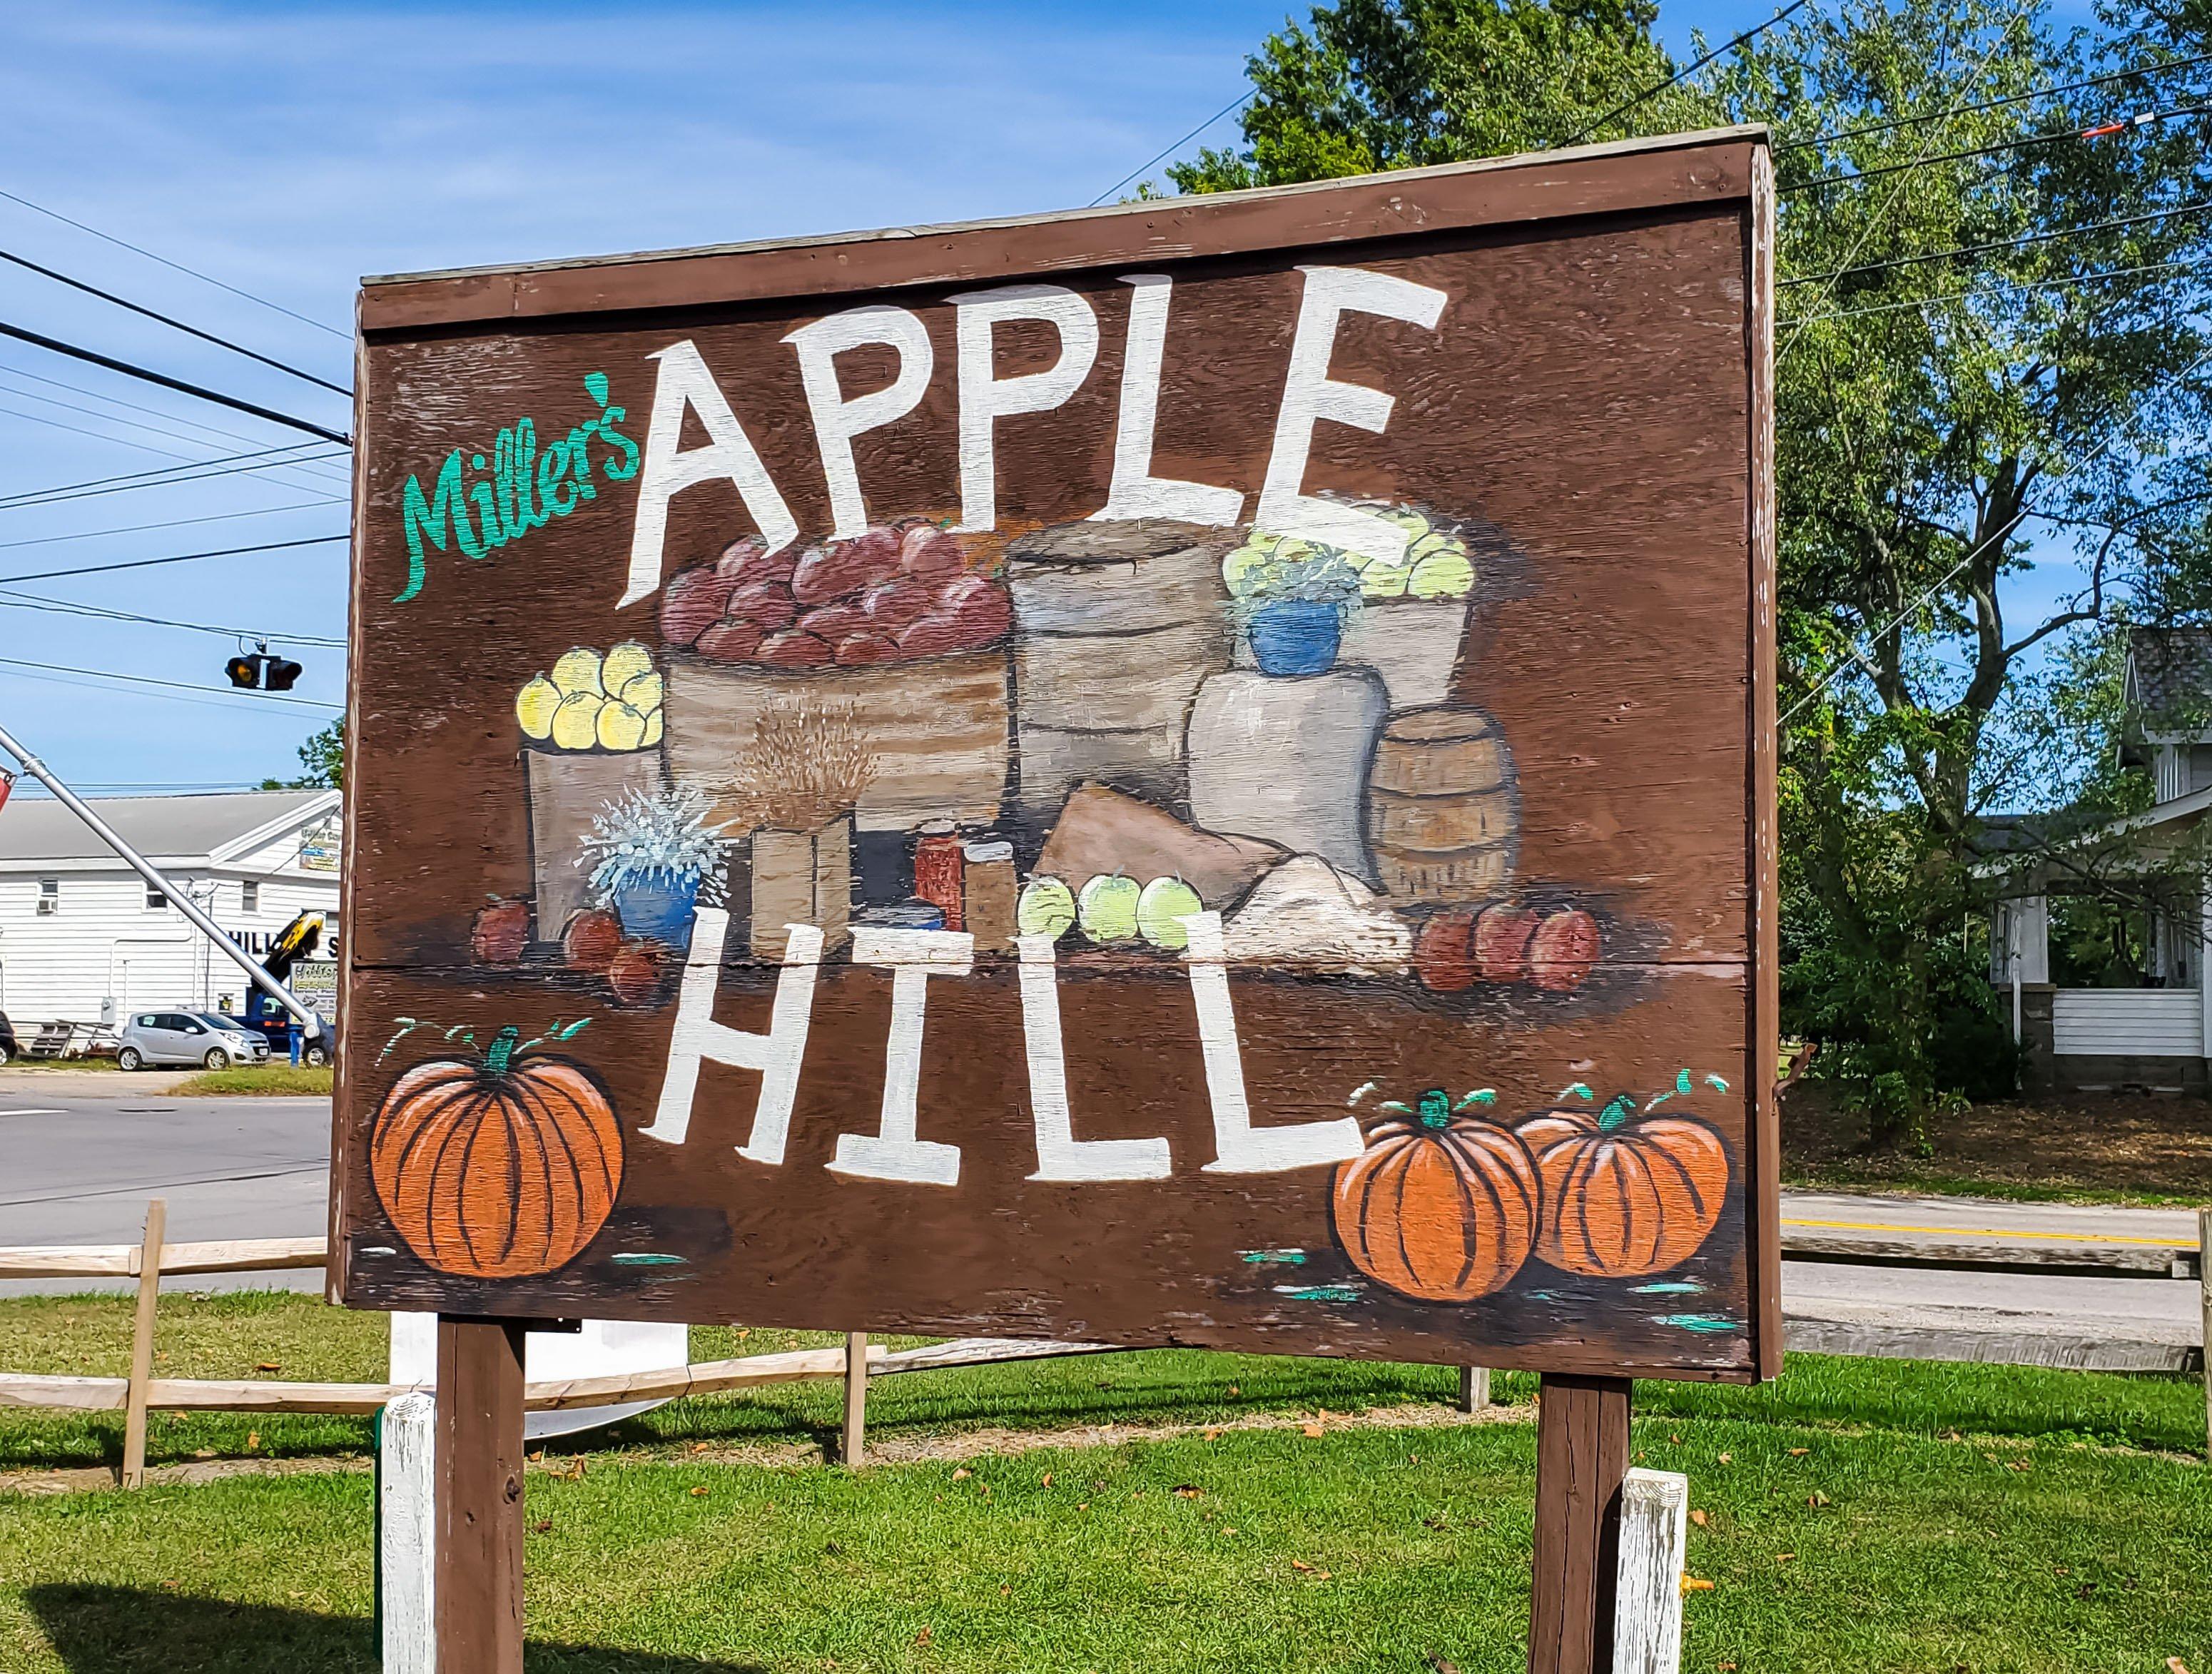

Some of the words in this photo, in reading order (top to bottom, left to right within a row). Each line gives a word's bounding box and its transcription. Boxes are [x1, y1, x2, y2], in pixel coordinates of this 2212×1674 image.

[392, 371, 640, 604] Miller's
[615, 265, 1449, 609] APPLE
[639, 906, 1366, 1186] HILL
